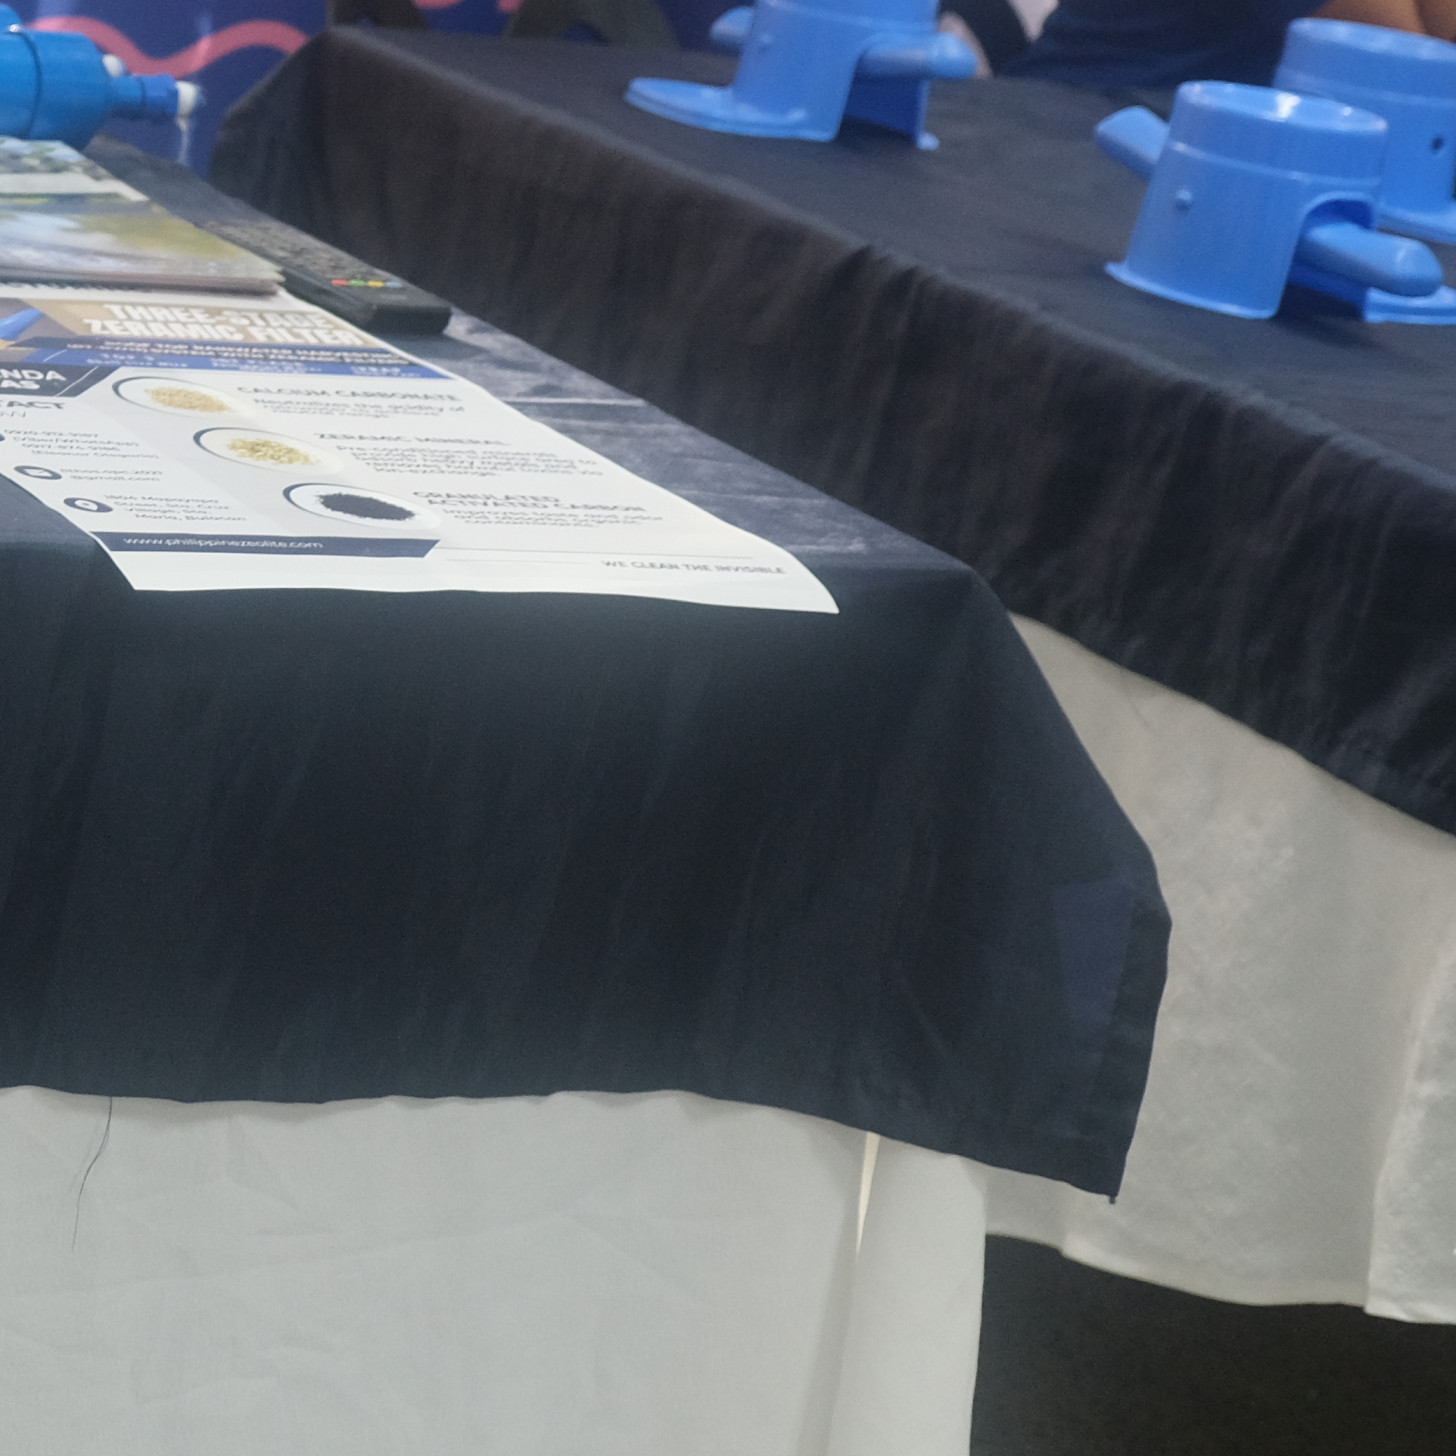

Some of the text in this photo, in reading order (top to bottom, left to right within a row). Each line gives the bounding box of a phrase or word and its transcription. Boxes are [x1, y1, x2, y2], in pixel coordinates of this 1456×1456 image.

[104, 304, 335, 329] THREE-STAGE
[83, 318, 364, 346] ZERAMIC FILTER
